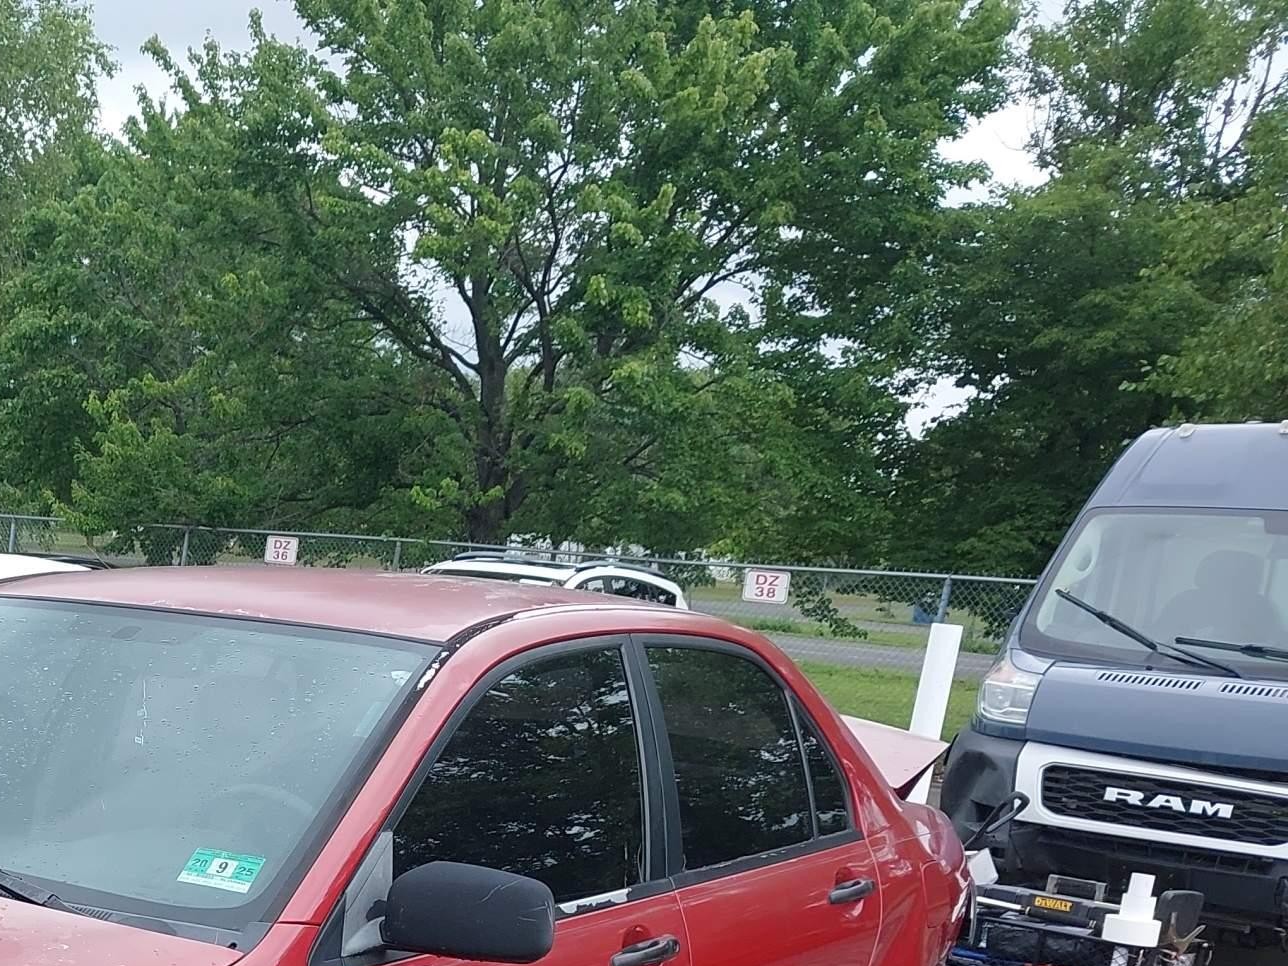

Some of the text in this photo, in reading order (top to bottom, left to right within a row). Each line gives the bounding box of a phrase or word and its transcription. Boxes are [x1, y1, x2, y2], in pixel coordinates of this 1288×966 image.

[273, 540, 291, 550] DZ
[272, 550, 288, 560] 36
[755, 574, 780, 587] DZ
[754, 586, 776, 598] 38
[1103, 786, 1234, 819] RAM
[192, 859, 256, 876] 20 9 25
